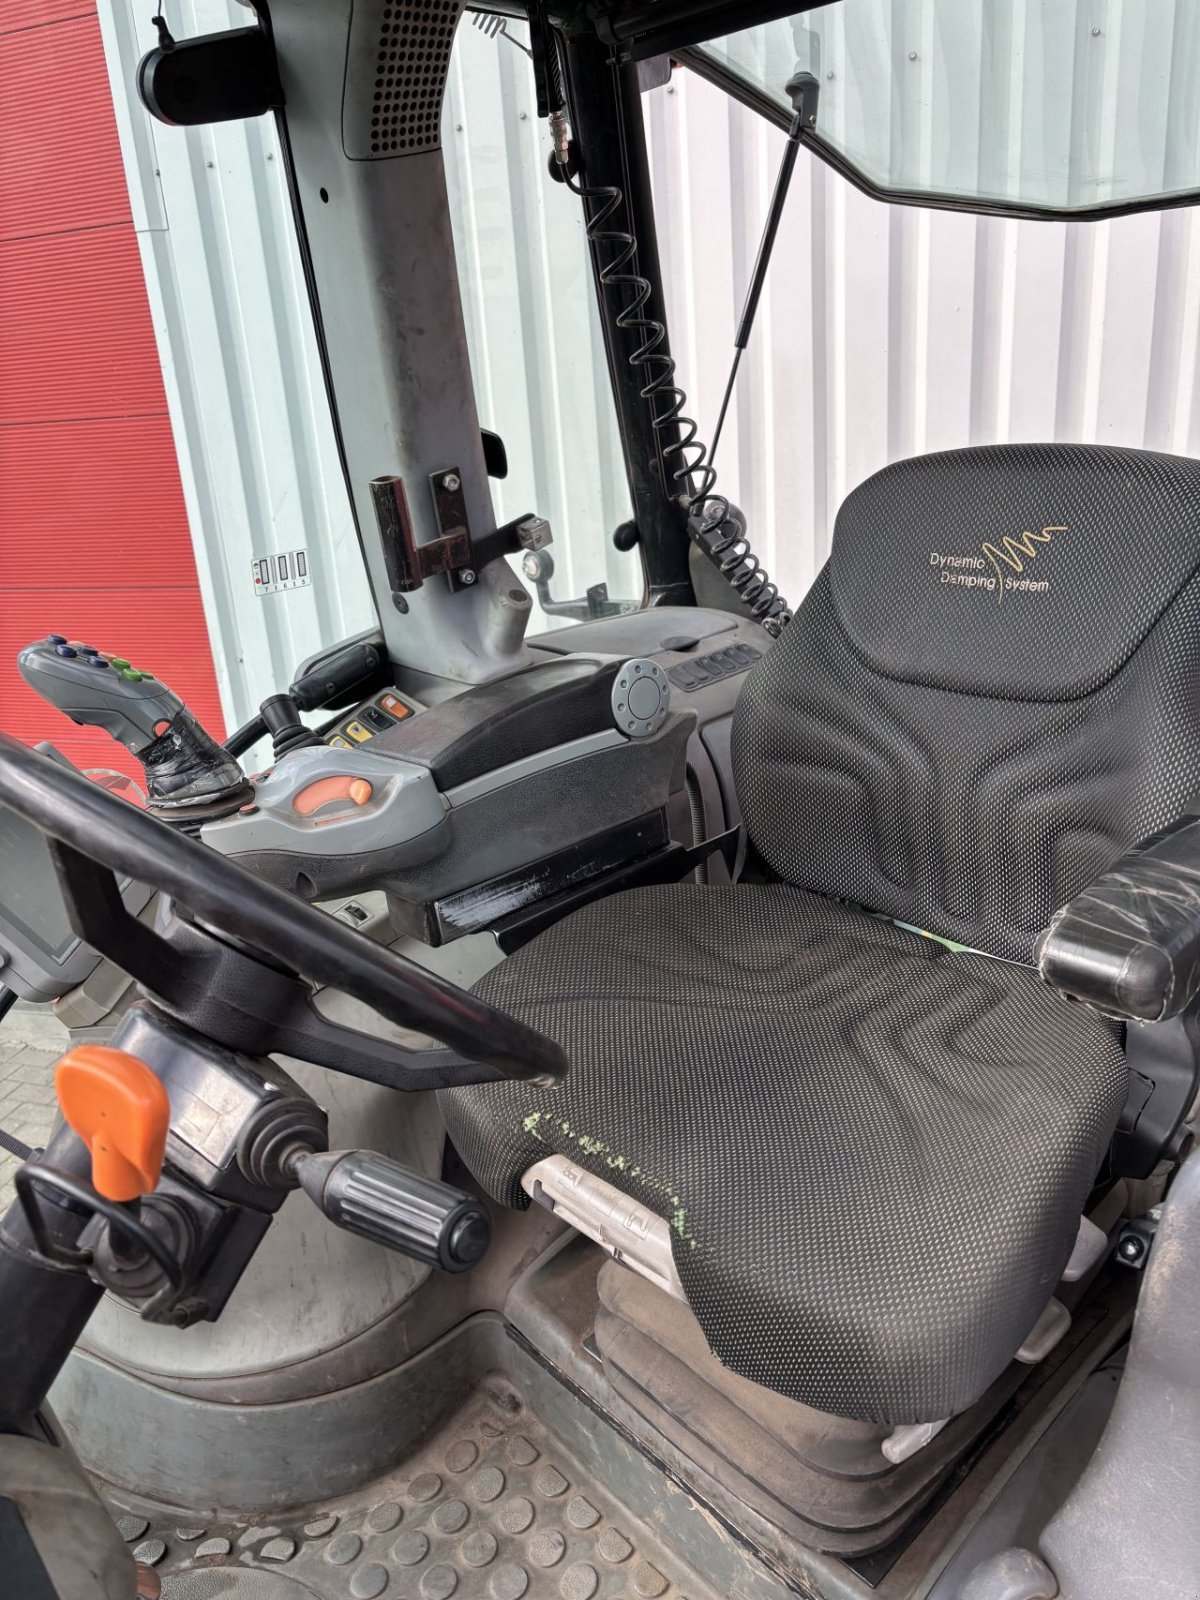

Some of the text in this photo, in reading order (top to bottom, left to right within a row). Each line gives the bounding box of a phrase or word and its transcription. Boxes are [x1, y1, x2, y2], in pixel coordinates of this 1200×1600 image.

[930, 552, 986, 569] Dynamic
[940, 571, 1050, 592] Damping System
